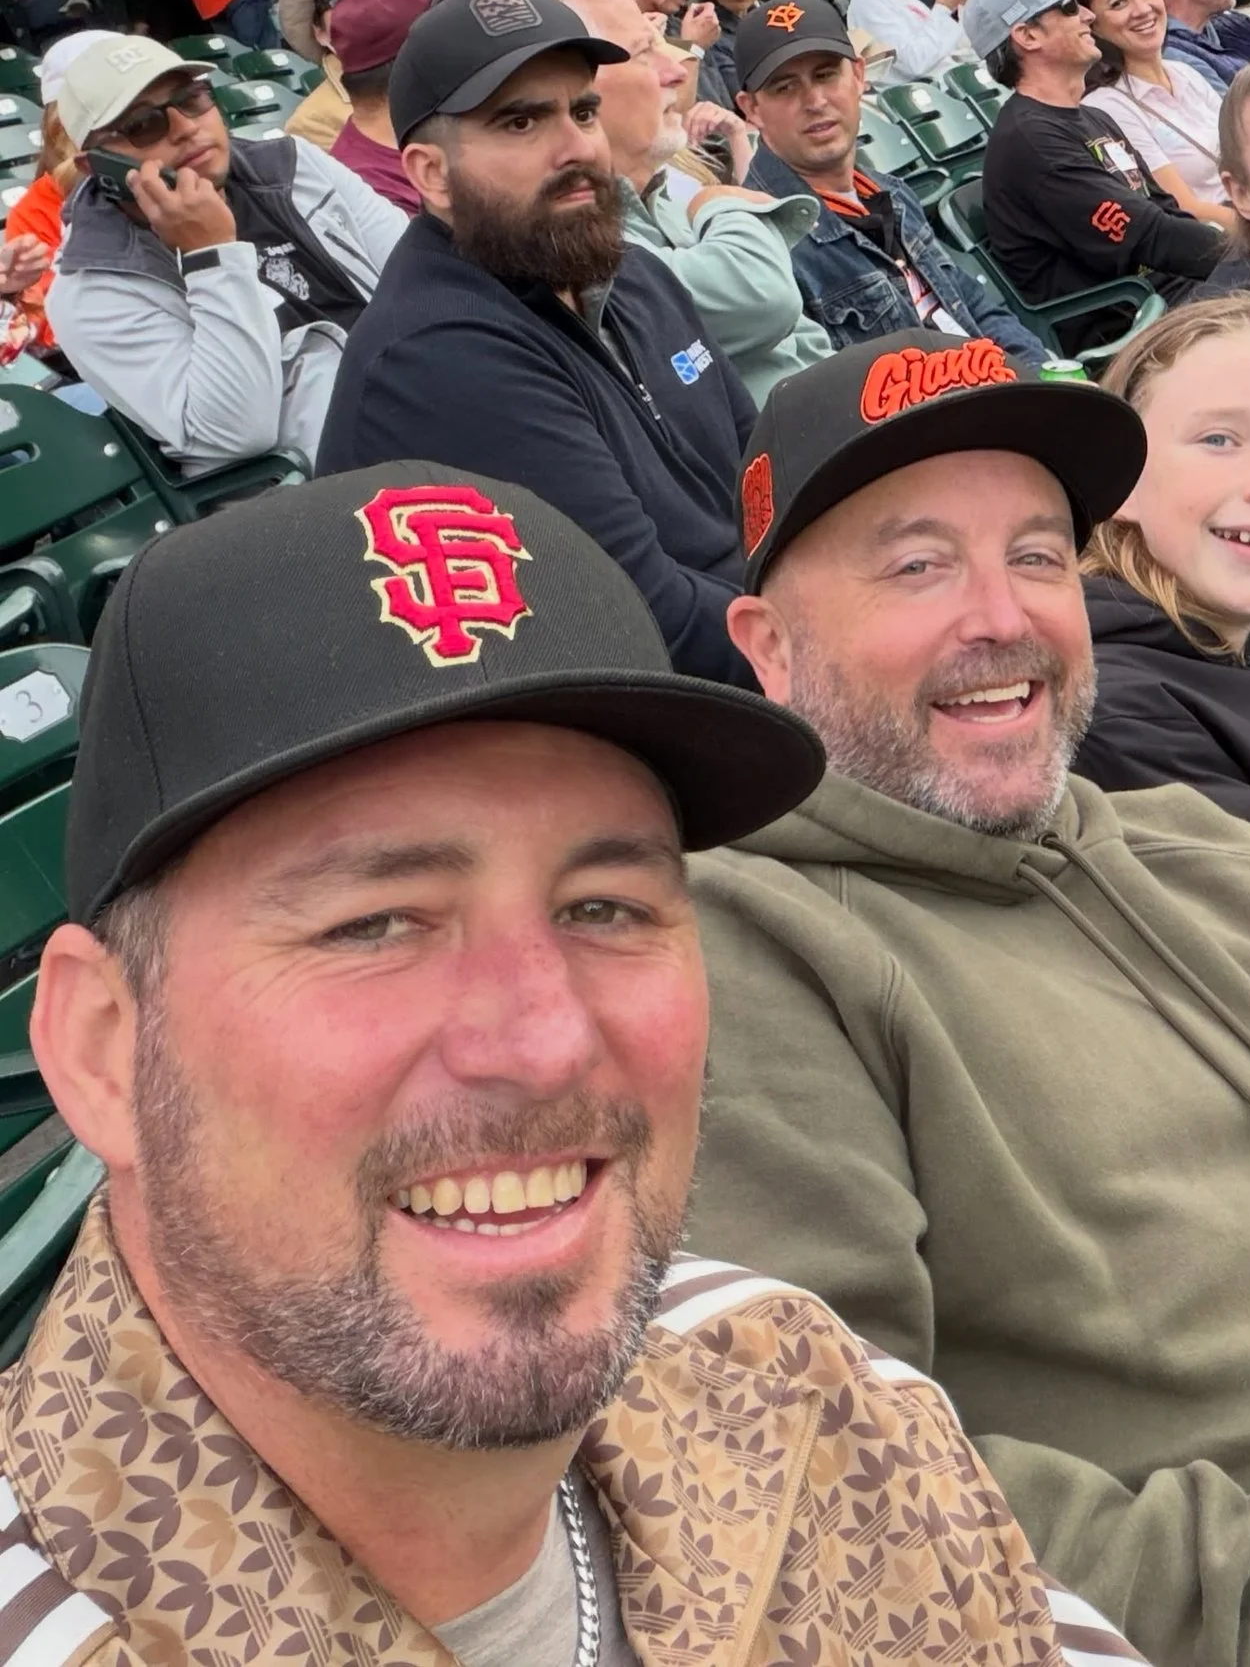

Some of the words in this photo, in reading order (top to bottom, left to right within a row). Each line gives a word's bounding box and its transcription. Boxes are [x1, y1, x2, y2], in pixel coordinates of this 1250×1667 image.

[861, 338, 1017, 424] Giants
[354, 486, 534, 667] SF
[15, 690, 43, 723] 3
